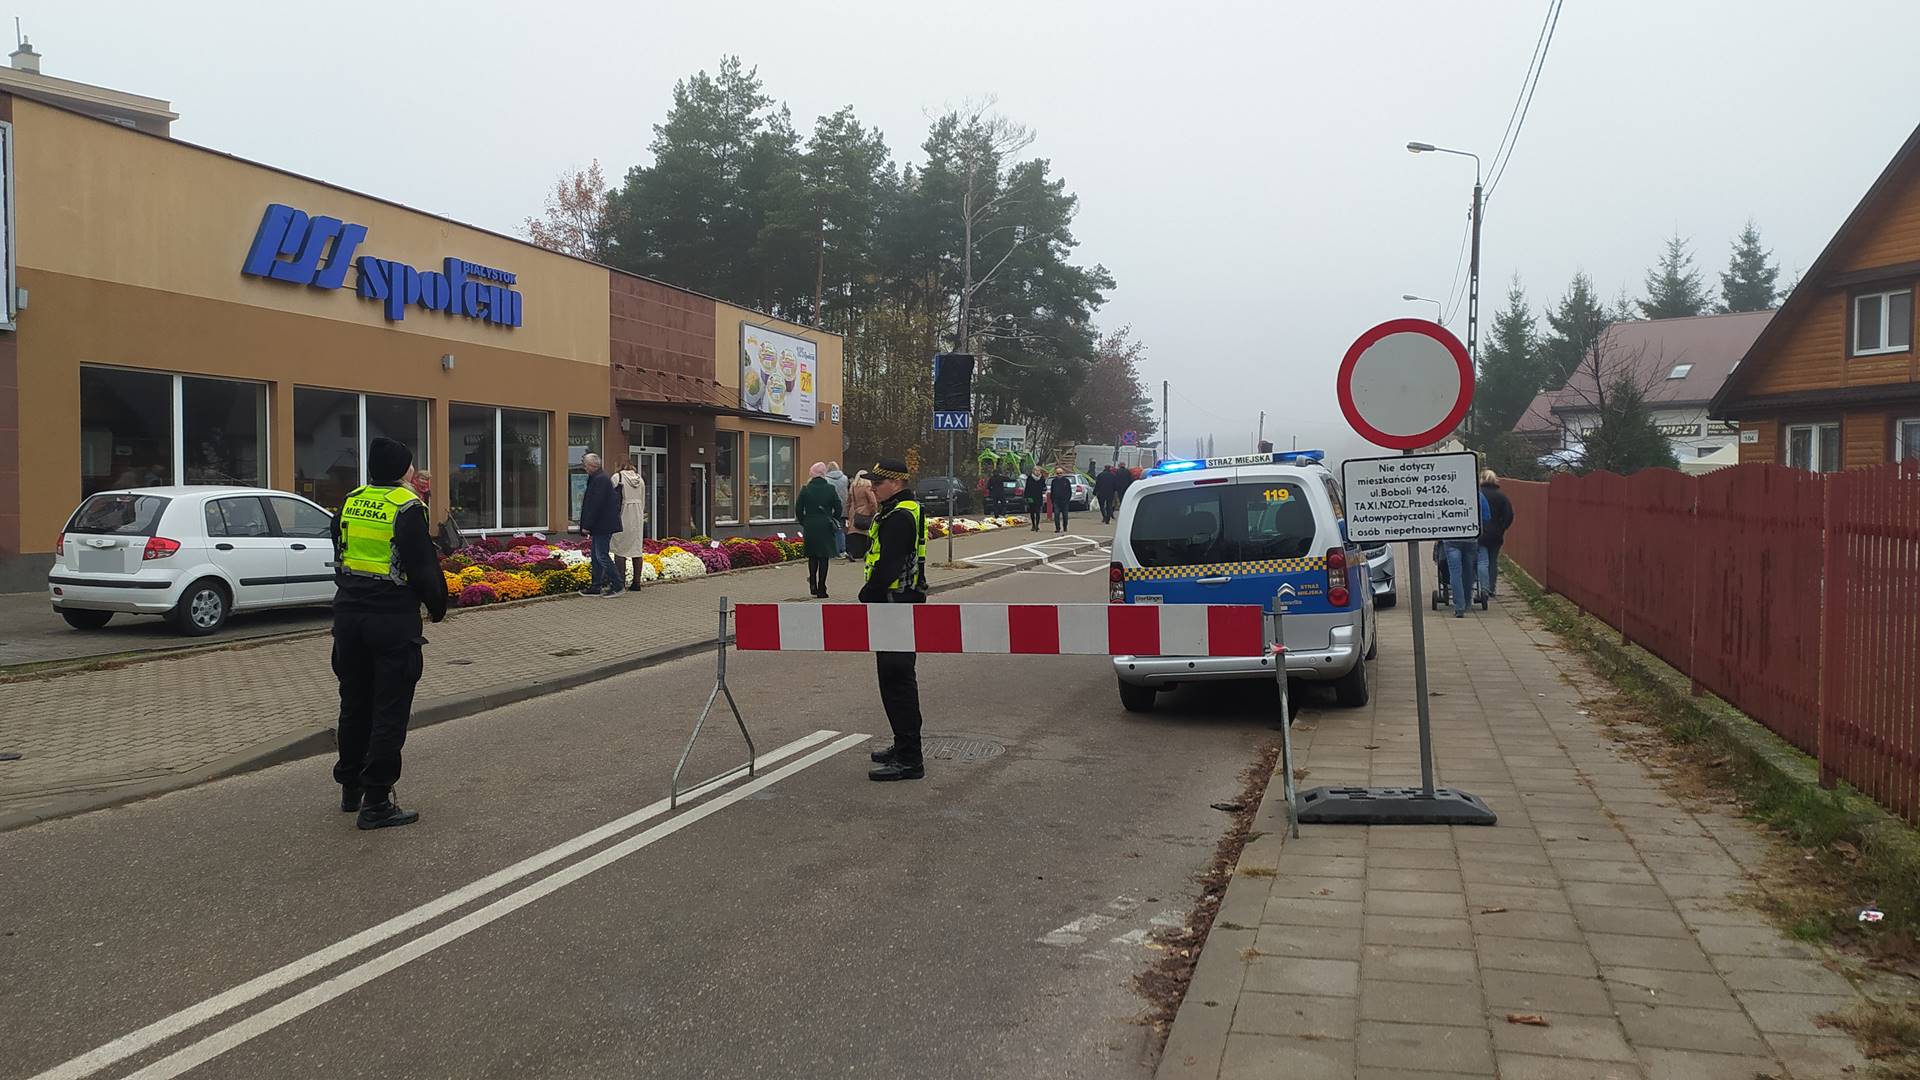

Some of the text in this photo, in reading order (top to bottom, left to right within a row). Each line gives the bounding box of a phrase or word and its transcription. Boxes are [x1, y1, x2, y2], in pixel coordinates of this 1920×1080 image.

[462, 262, 517, 285] BIAŁYSTOK
[832, 405, 839, 419] 95
[935, 414, 968, 428] TAXI
[1235, 455, 1271, 464] MIEJSKA
[1378, 463, 1435, 472] Nie dotyczy
[1357, 472, 1457, 485] mieszkańców posesji
[1263, 488, 1290, 502] 119
[1370, 487, 1412, 497] ul.Boboli
[344, 507, 387, 520] MIEJSKA
[1353, 511, 1435, 524] Autowypożyczalni
[1350, 522, 1479, 537] i osób niepełnosprawnych
